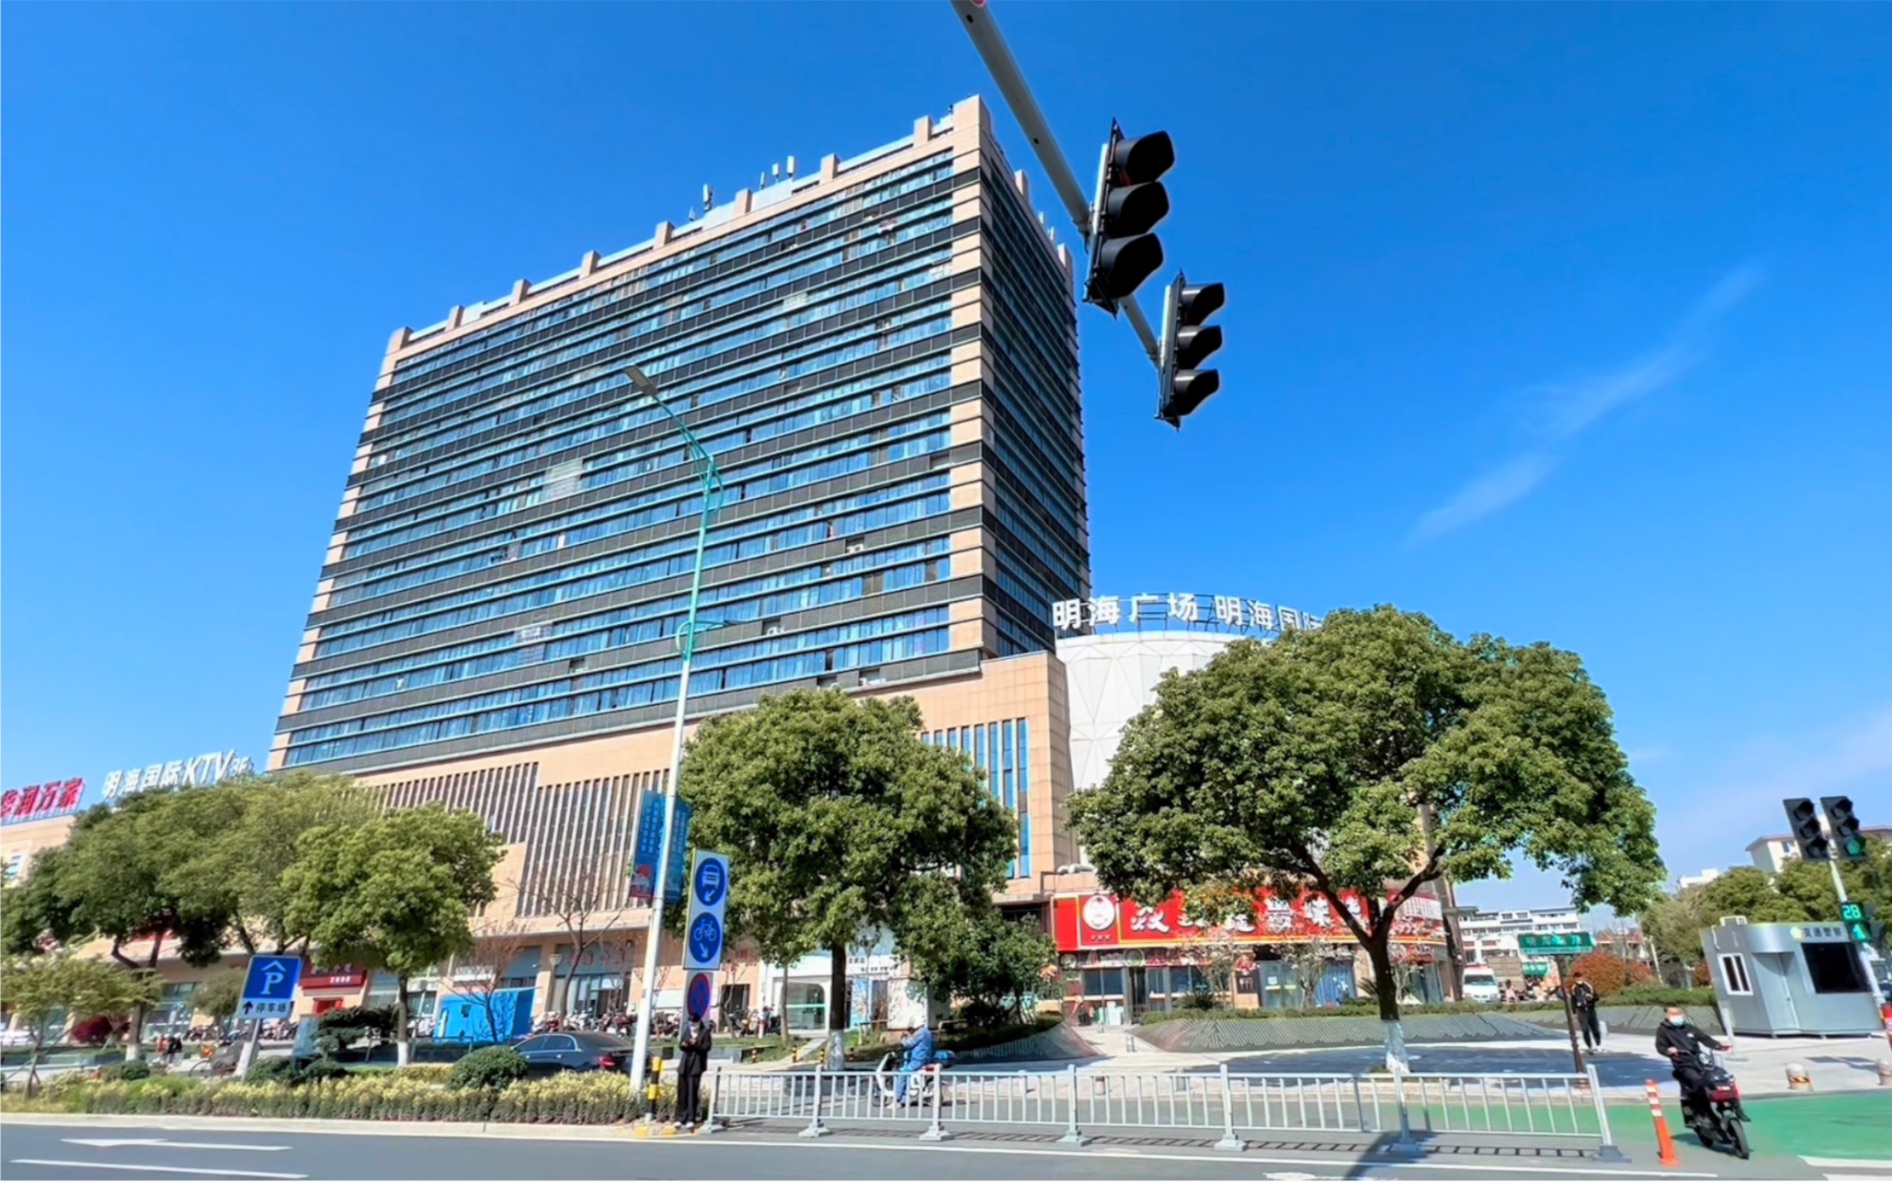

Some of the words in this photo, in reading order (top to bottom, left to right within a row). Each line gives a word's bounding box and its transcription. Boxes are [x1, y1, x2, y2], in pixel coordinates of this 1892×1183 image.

[1052, 592, 1198, 631] 明海广场
[1841, 904, 1862, 920] 28
[260, 971, 285, 996] P
[255, 1002, 288, 1014] 停车场
